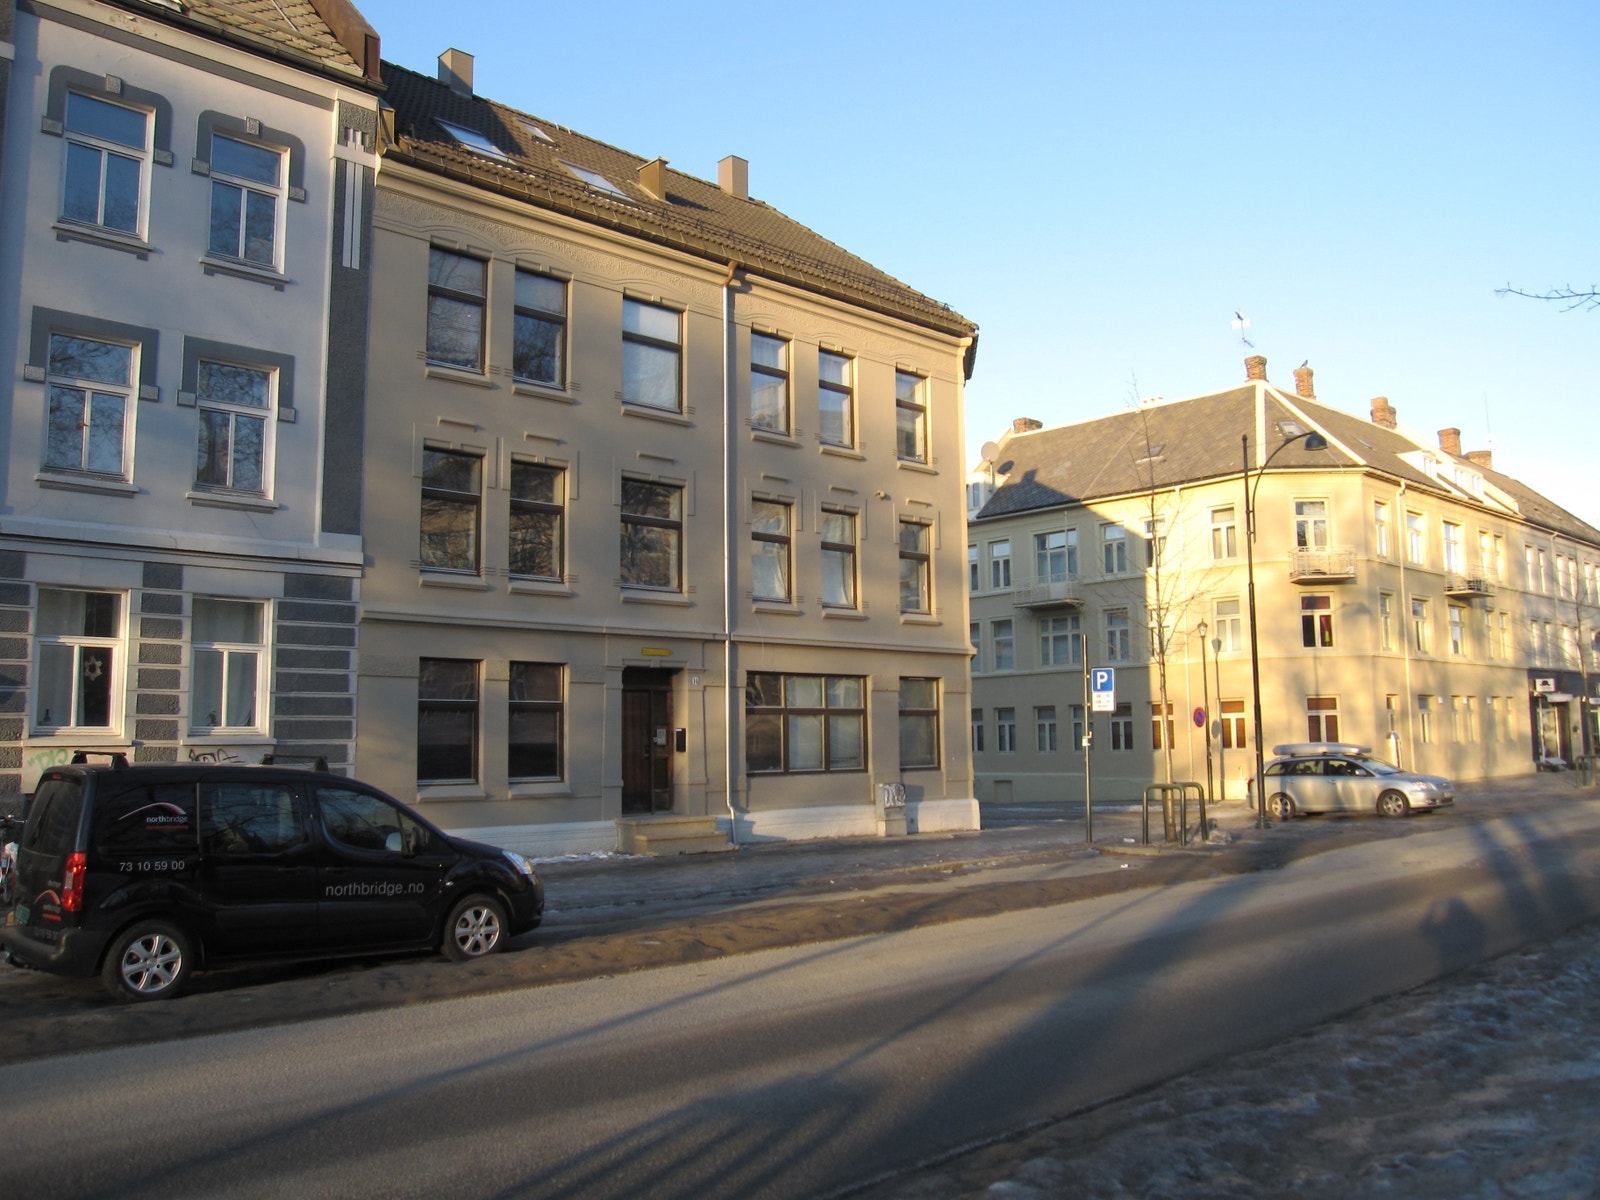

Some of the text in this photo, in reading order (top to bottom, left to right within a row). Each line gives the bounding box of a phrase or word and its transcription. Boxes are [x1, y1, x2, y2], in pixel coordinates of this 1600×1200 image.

[1097, 671, 1108, 690] P
[146, 815, 188, 824] northbridge
[120, 860, 185, 872] 73 10 59 00
[325, 881, 425, 896] northbridge.no
